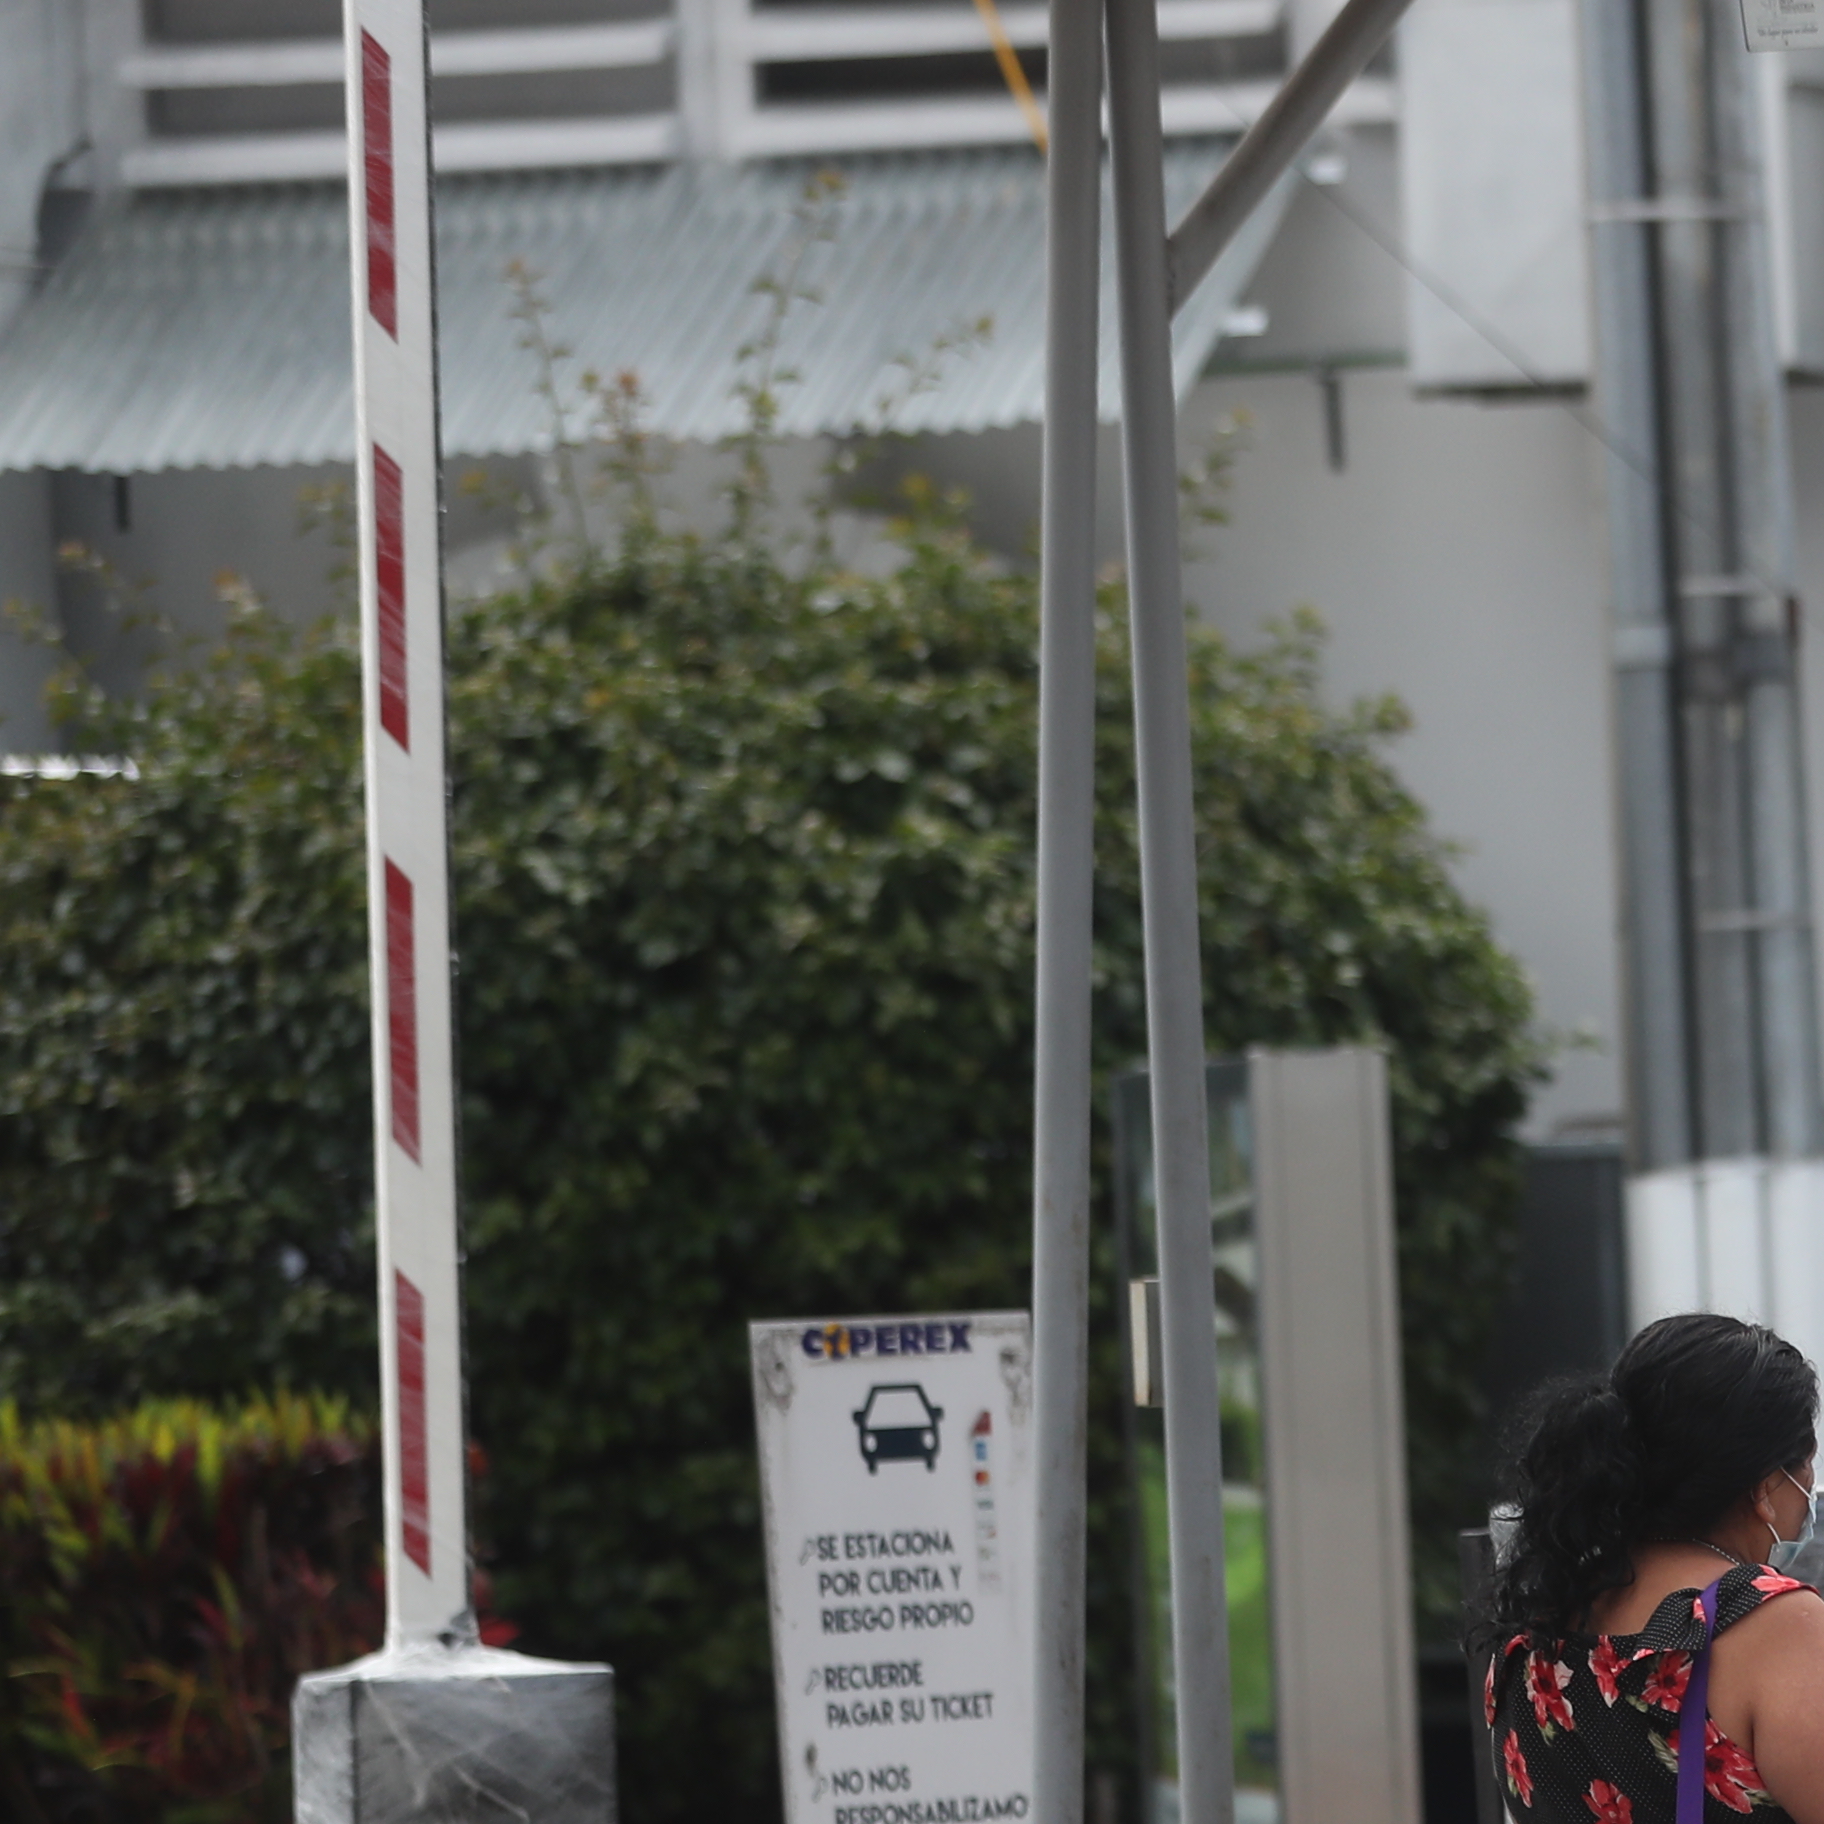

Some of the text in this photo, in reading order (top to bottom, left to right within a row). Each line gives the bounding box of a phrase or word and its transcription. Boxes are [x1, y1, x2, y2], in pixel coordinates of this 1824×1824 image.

[817, 1531, 954, 1561] SE ESTACIONA
[819, 1565, 962, 1597] POR CUENTA Y
[822, 1601, 974, 1634] RIESGO PROPIO
[824, 1660, 923, 1691] RECUERDE
[827, 1692, 993, 1729] PAGAR SU TICKET
[832, 1765, 911, 1795] NO NOS
